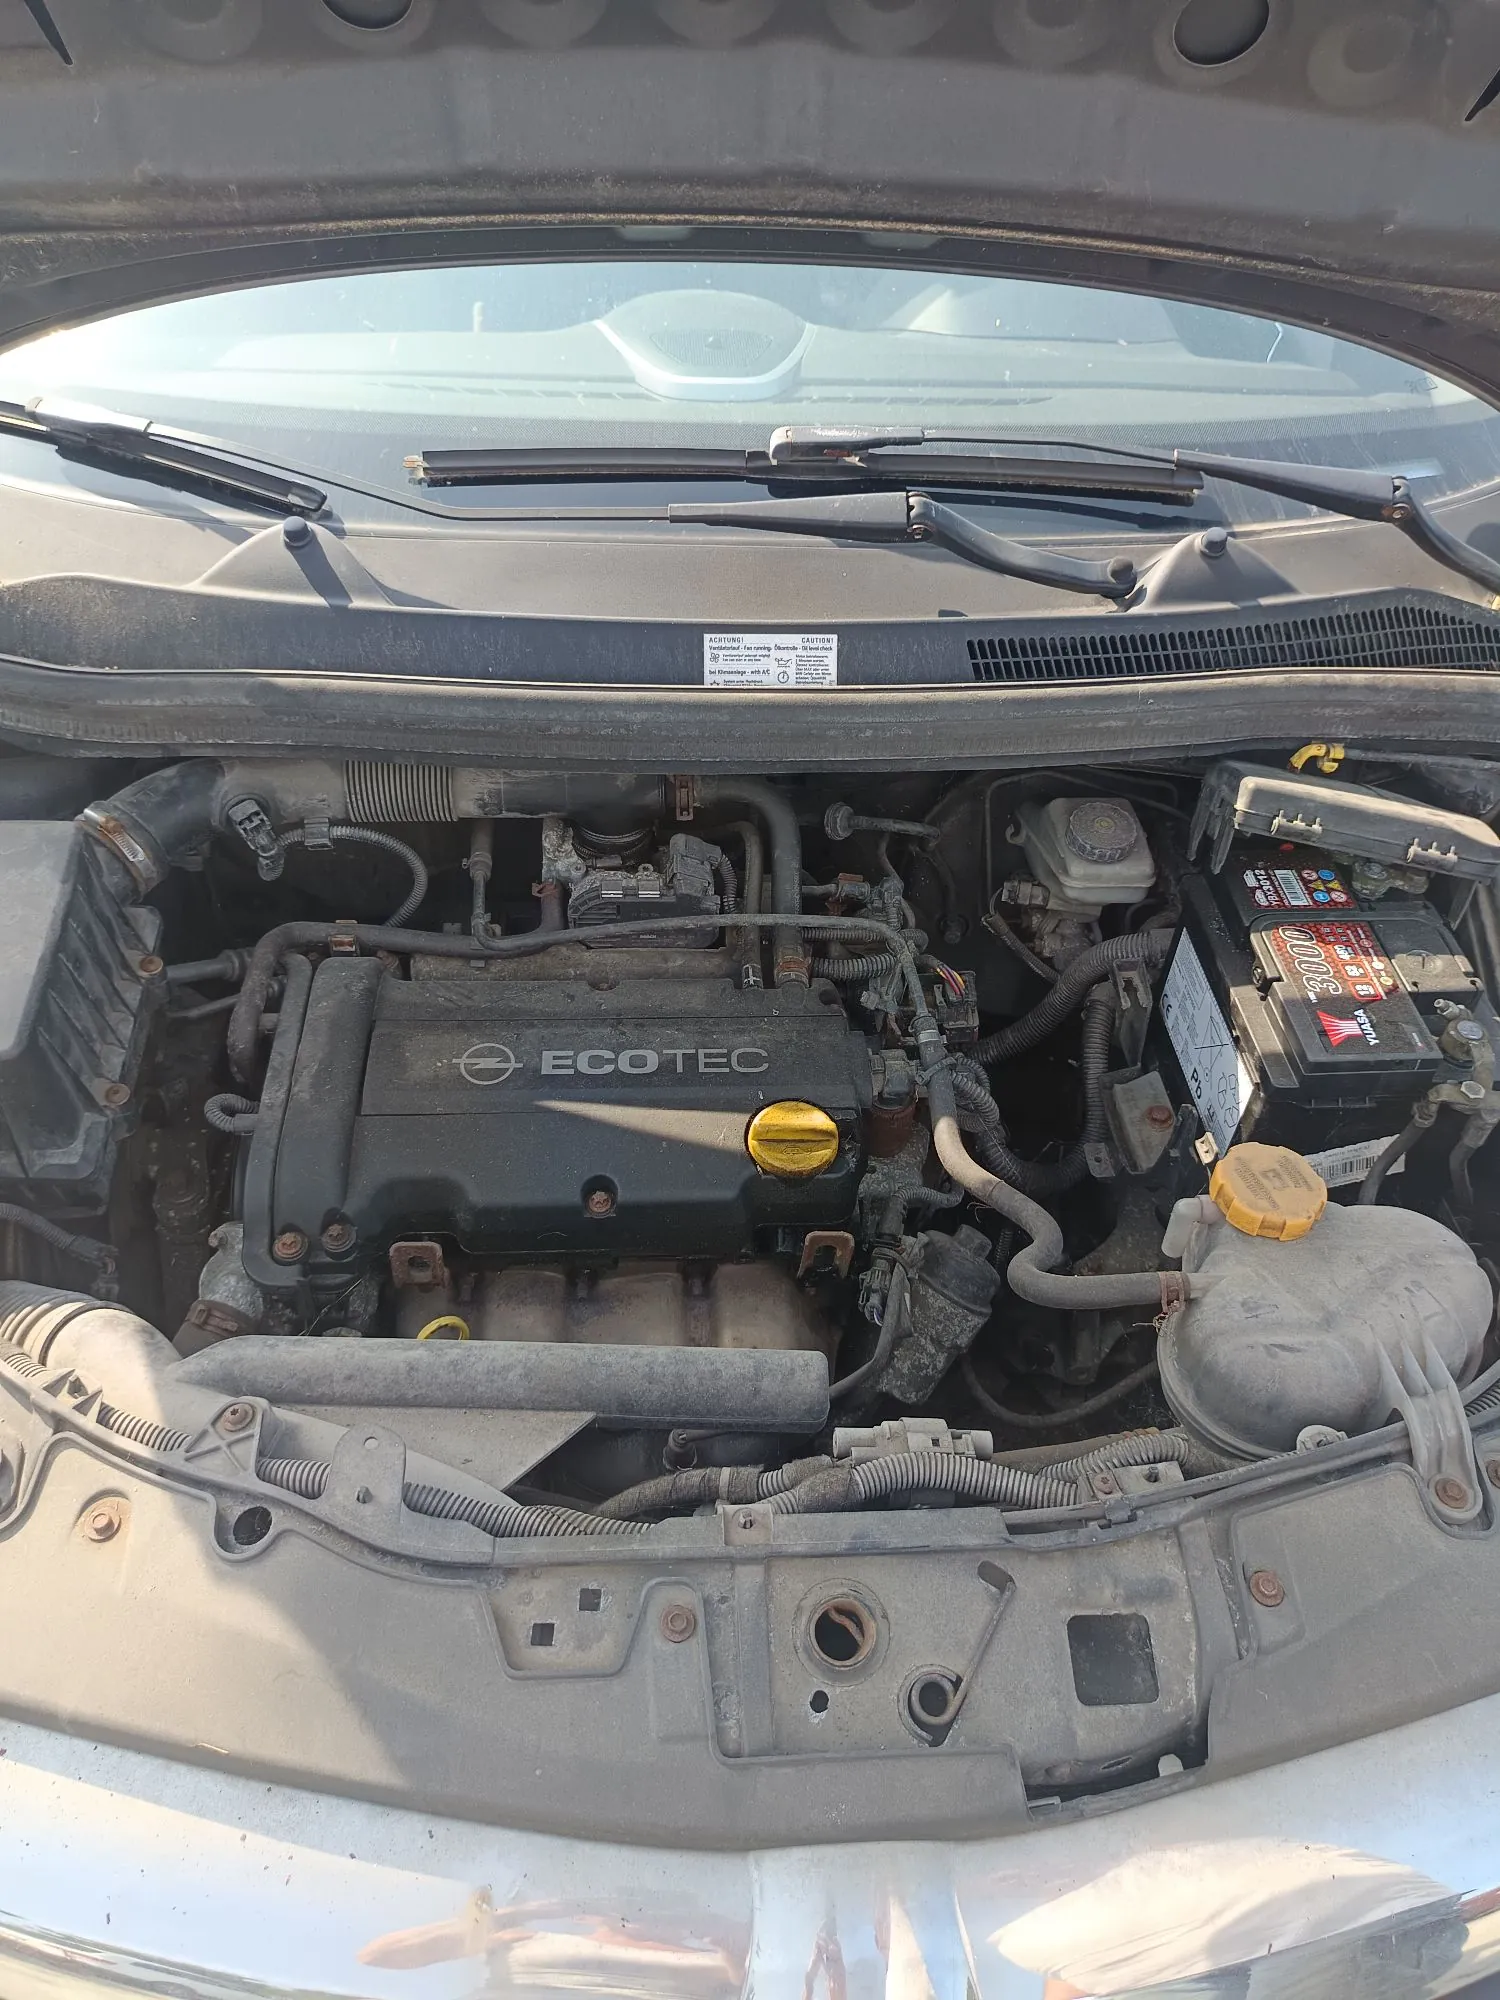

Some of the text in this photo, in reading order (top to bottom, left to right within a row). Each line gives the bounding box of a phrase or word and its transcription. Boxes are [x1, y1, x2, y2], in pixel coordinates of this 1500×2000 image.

[1254, 869, 1281, 906] YBX3012
[1279, 926, 1342, 995] 3000
[1354, 1008, 1379, 1046] YUASA
[541, 1048, 769, 1075] ECOTEC
[1190, 1067, 1202, 1099] Pb
